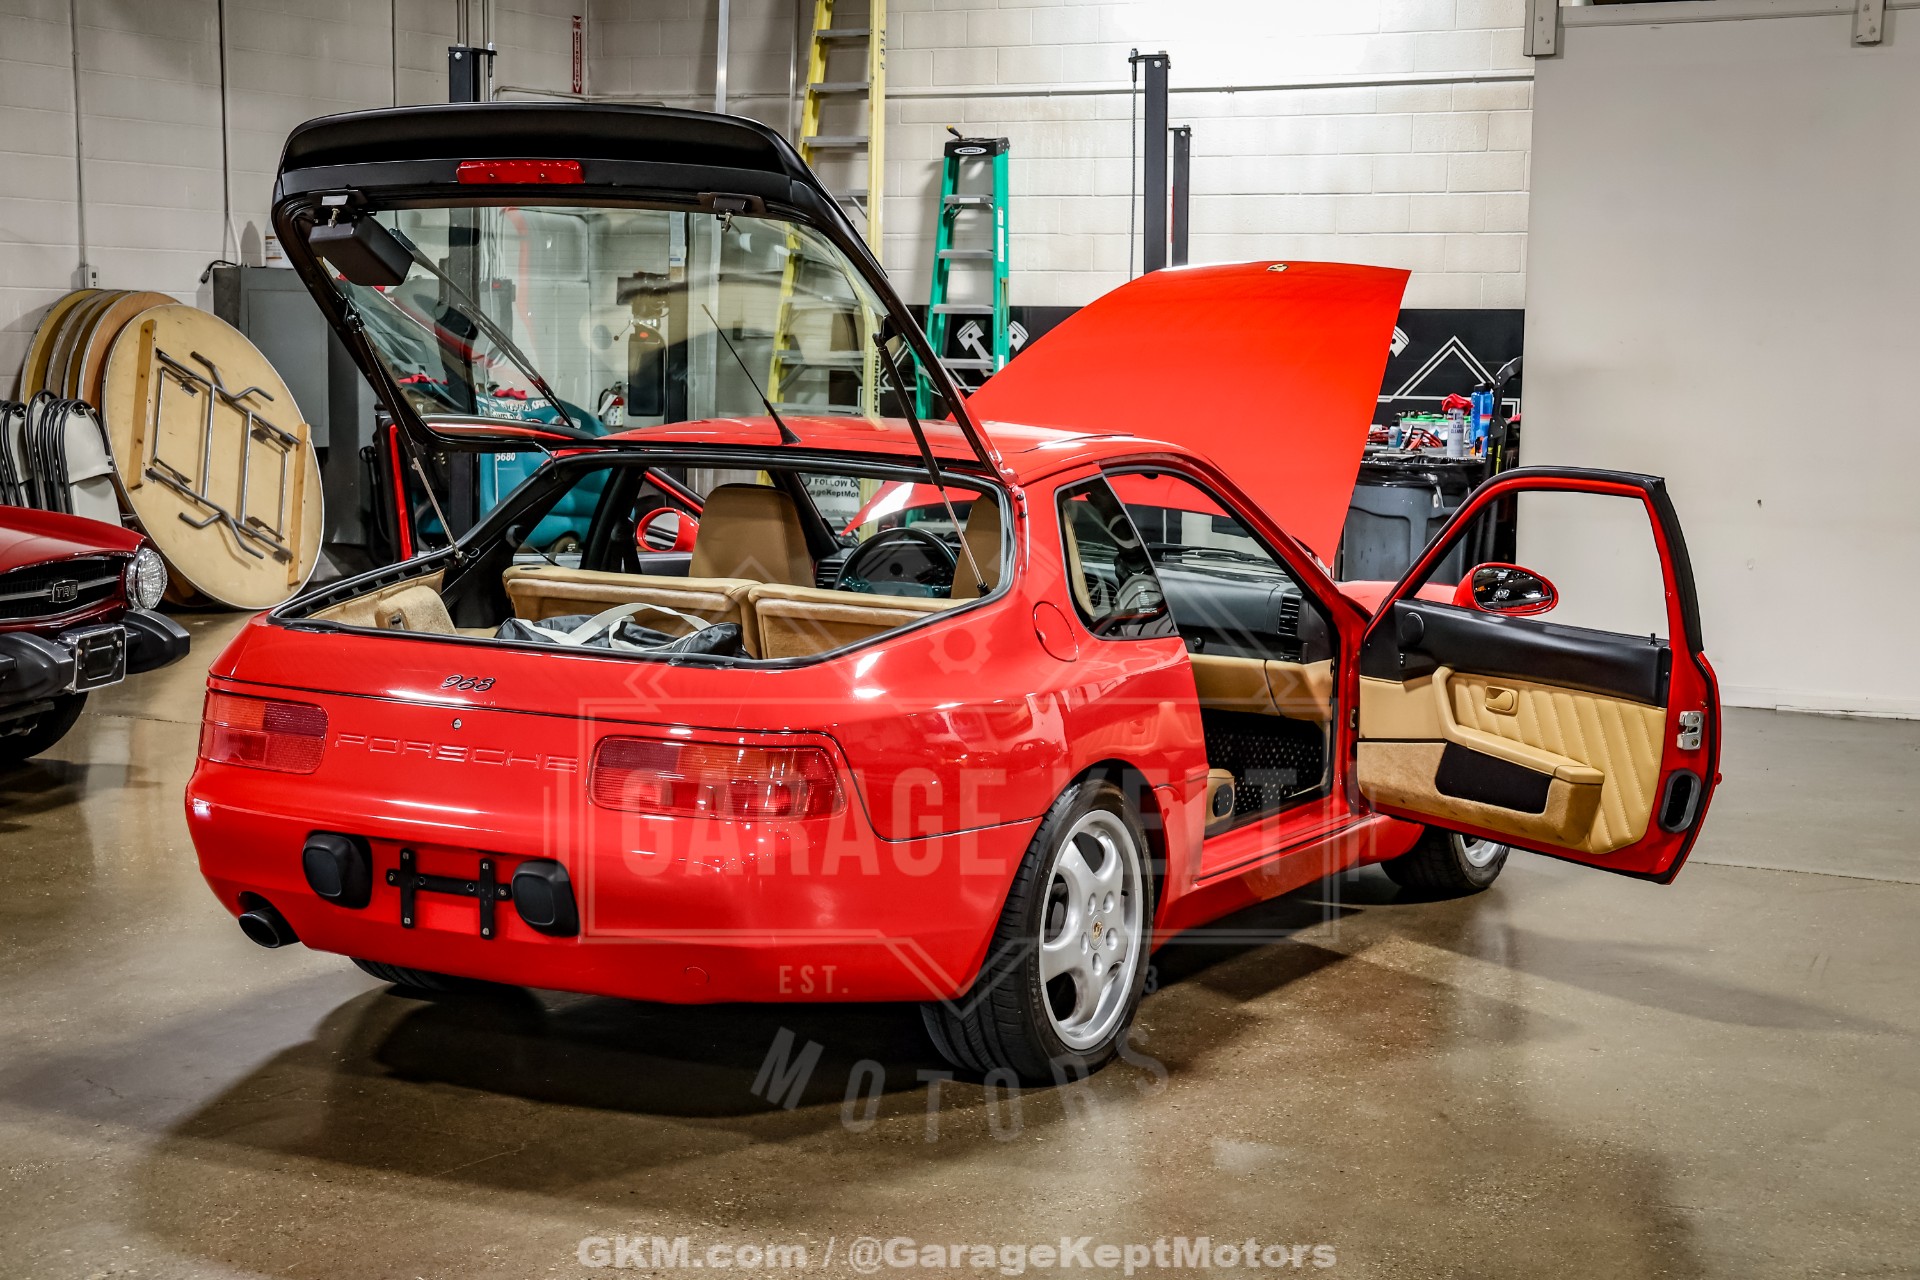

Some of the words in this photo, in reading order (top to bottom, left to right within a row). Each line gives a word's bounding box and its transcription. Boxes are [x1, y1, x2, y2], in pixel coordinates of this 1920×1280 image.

[814, 478, 848, 487] FOLLOW
[809, 489, 859, 497] ageKeptMot
[441, 675, 496, 691] 968
[334, 732, 579, 773] PORSCHE
